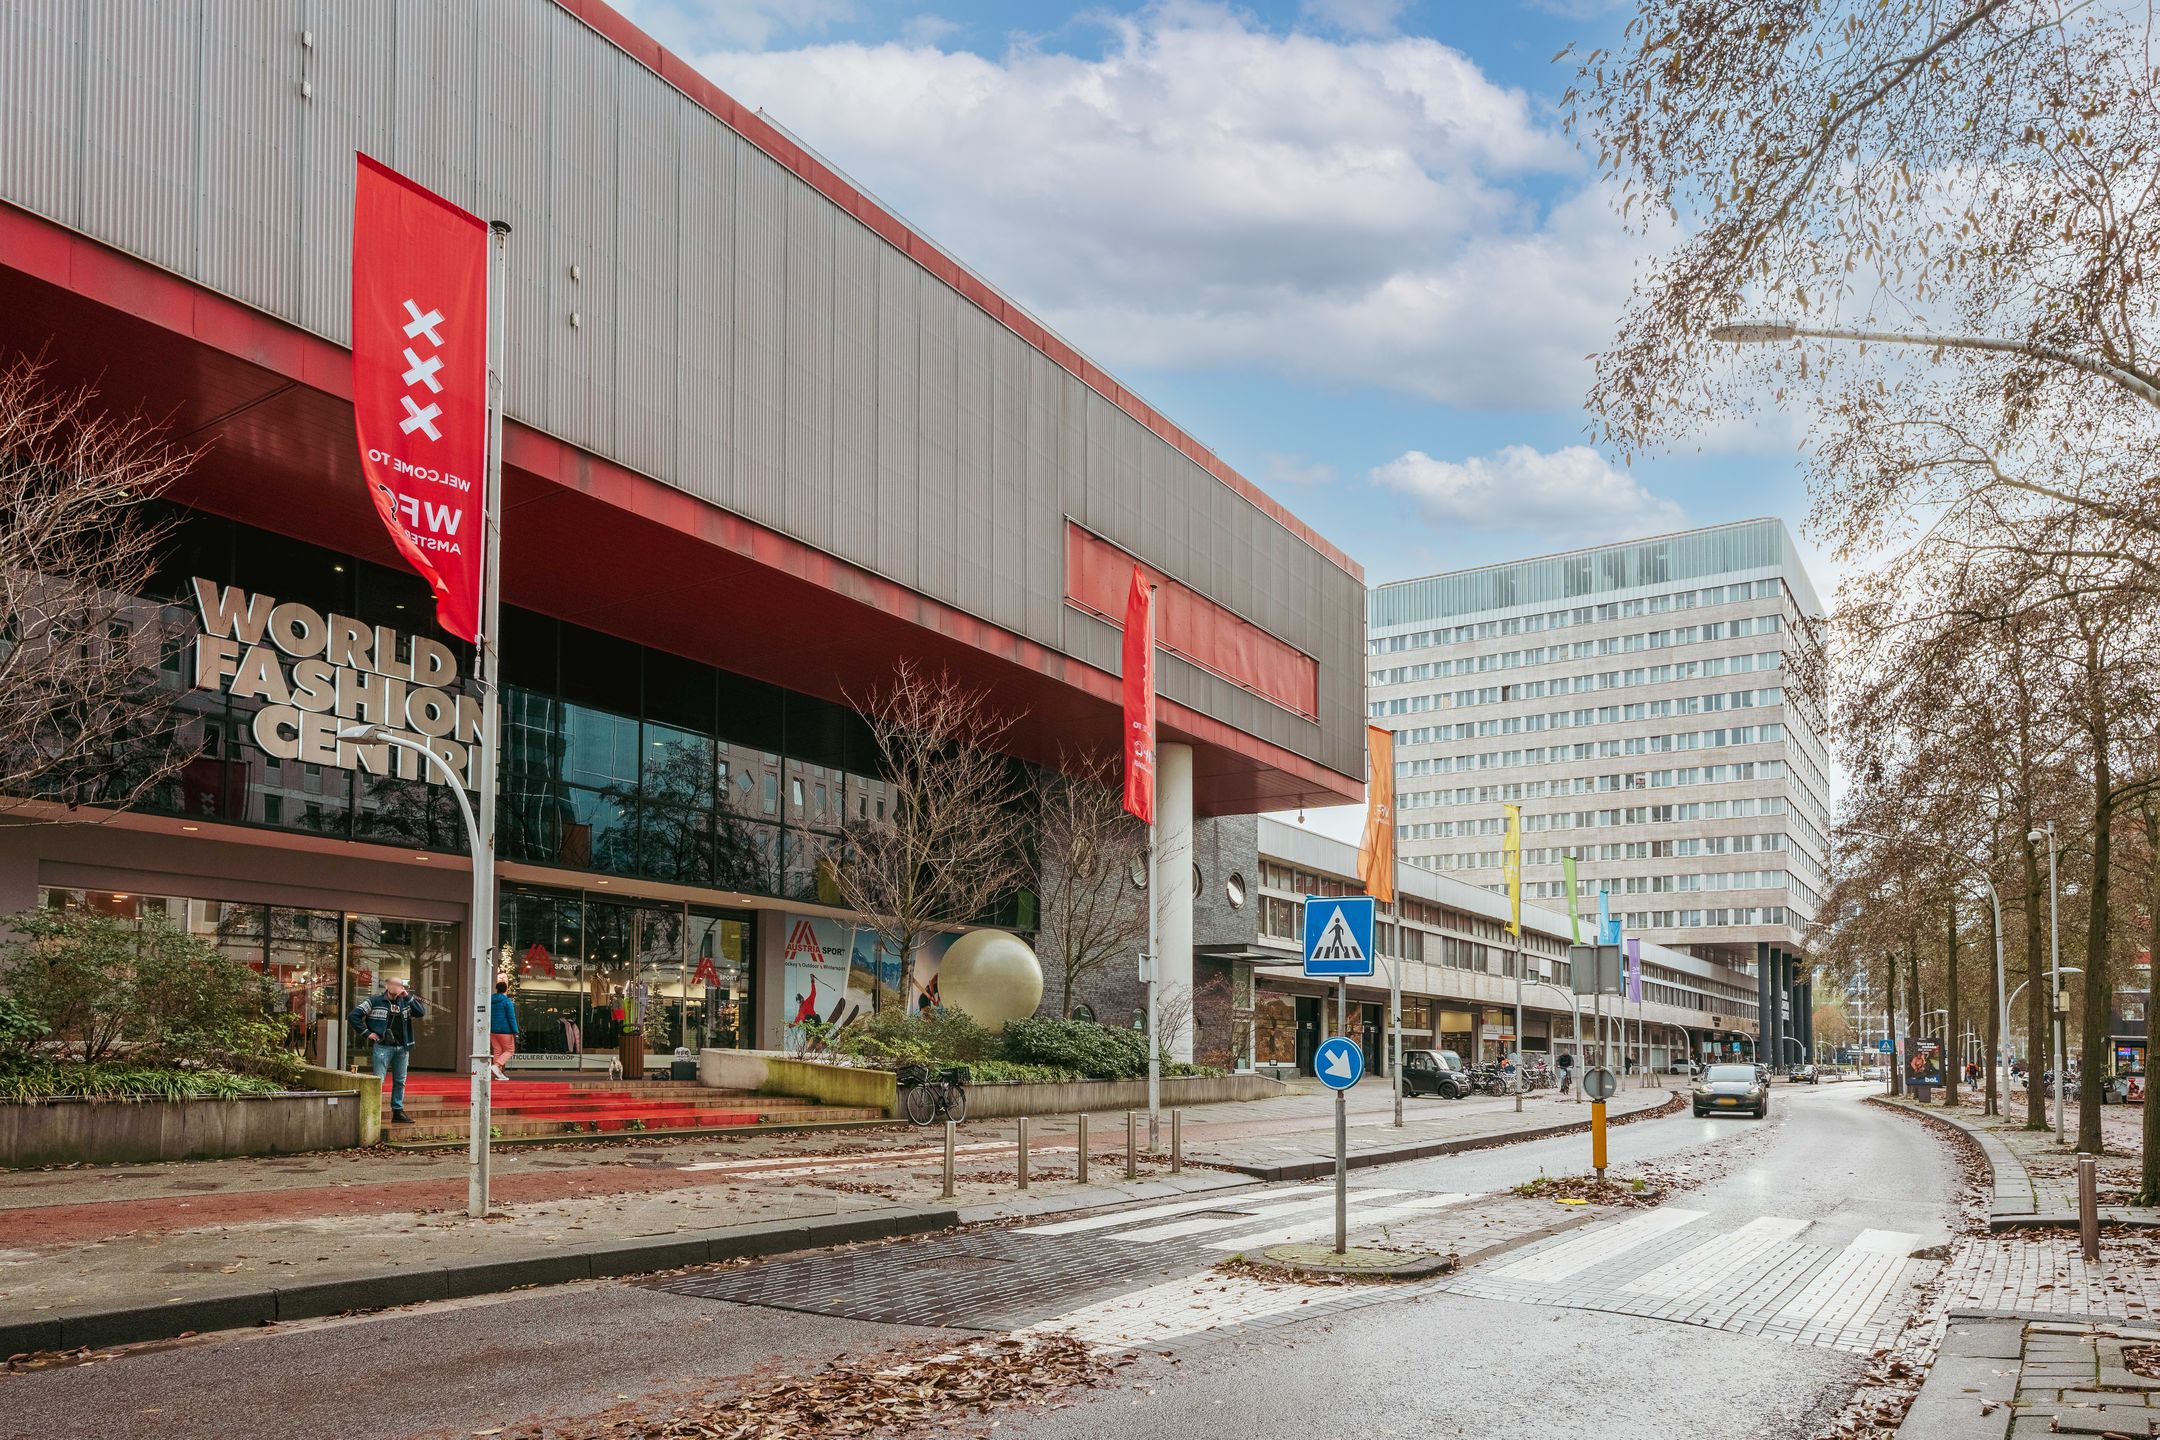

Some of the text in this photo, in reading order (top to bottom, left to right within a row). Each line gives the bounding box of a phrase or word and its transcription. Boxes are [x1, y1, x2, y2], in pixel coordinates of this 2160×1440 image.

[192, 576, 458, 688] WORLD
[195, 633, 502, 749] FASHION
[786, 943, 846, 956] AUSTRIA SPORT
[554, 963, 578, 971] SPORT
[784, 961, 798, 969] ockey
[545, 1054, 575, 1062] VERKOOP
